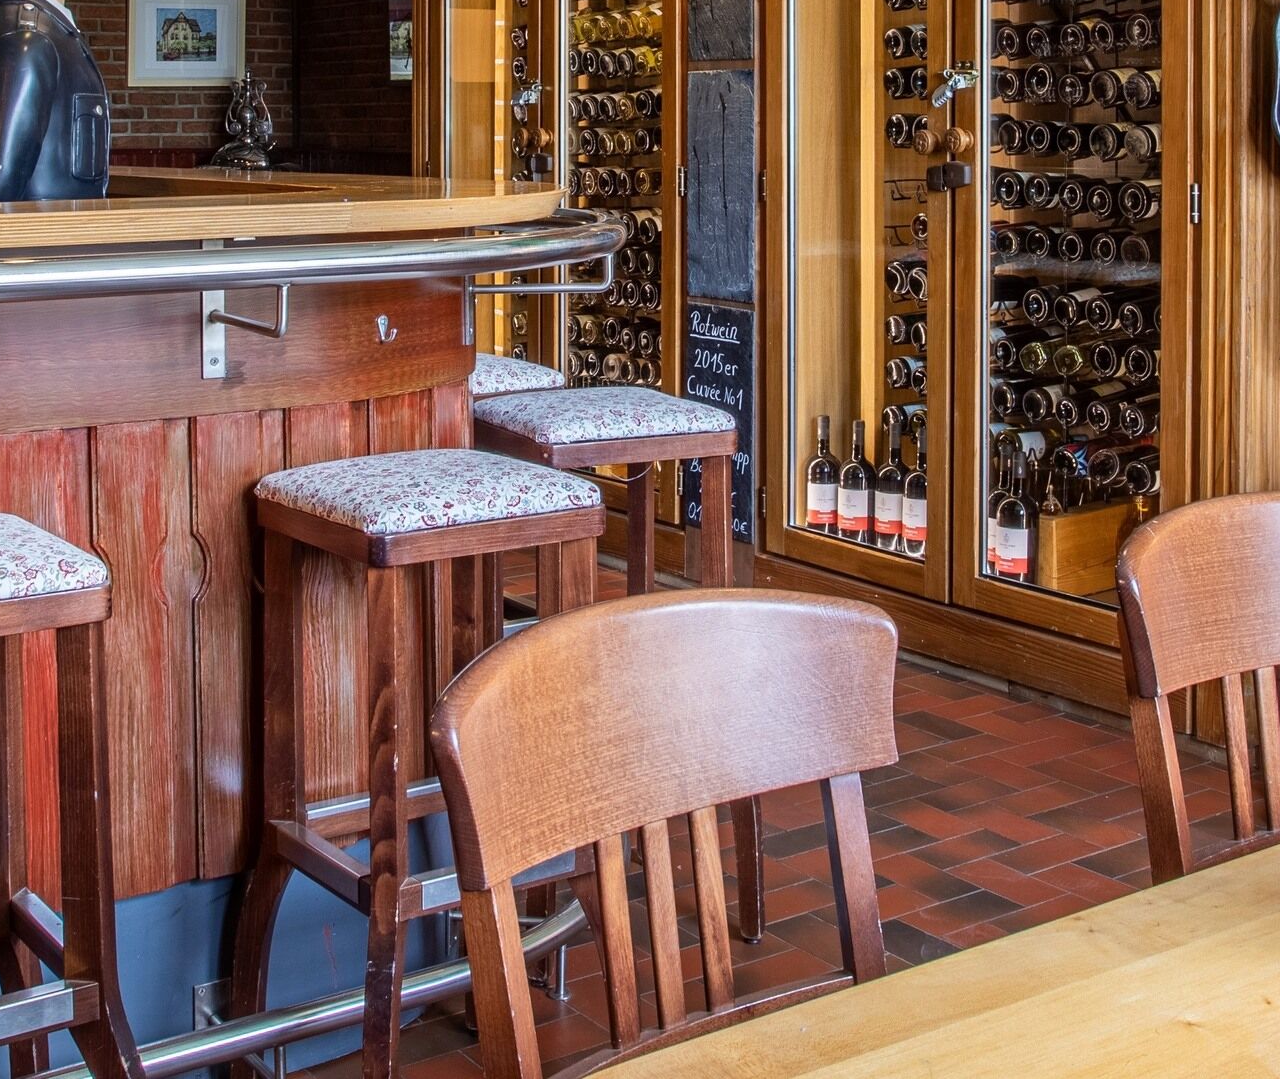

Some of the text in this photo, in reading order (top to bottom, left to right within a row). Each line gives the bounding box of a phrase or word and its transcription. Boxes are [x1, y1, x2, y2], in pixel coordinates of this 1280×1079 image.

[691, 311, 738, 340] Rotwein
[694, 349, 738, 376] 2015er
[687, 375, 721, 401] Cuvée
